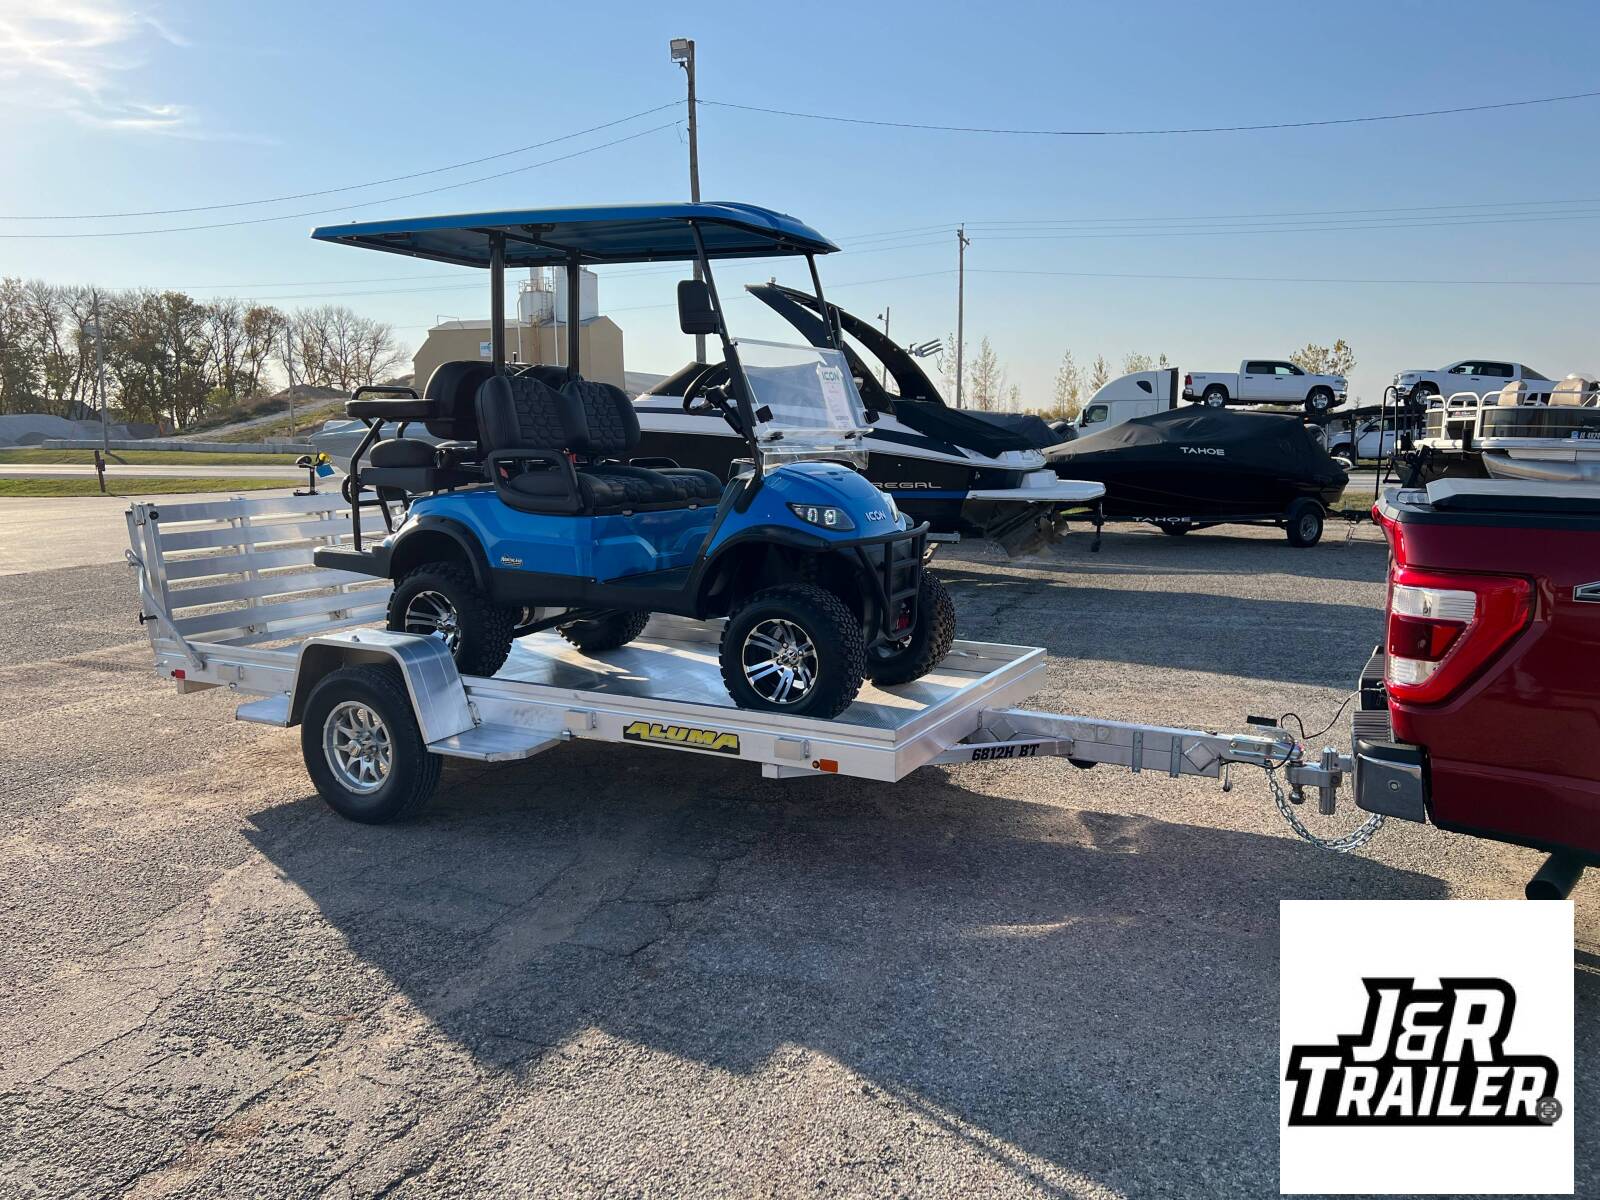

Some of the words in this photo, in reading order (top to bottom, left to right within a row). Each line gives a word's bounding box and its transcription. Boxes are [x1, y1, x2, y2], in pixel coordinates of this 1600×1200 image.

[1180, 446, 1225, 456] TAHOE
[865, 510, 887, 522] ICON
[624, 721, 739, 750] ALUMA
[972, 745, 1015, 761] 6812H
[1018, 743, 1040, 757] BT
